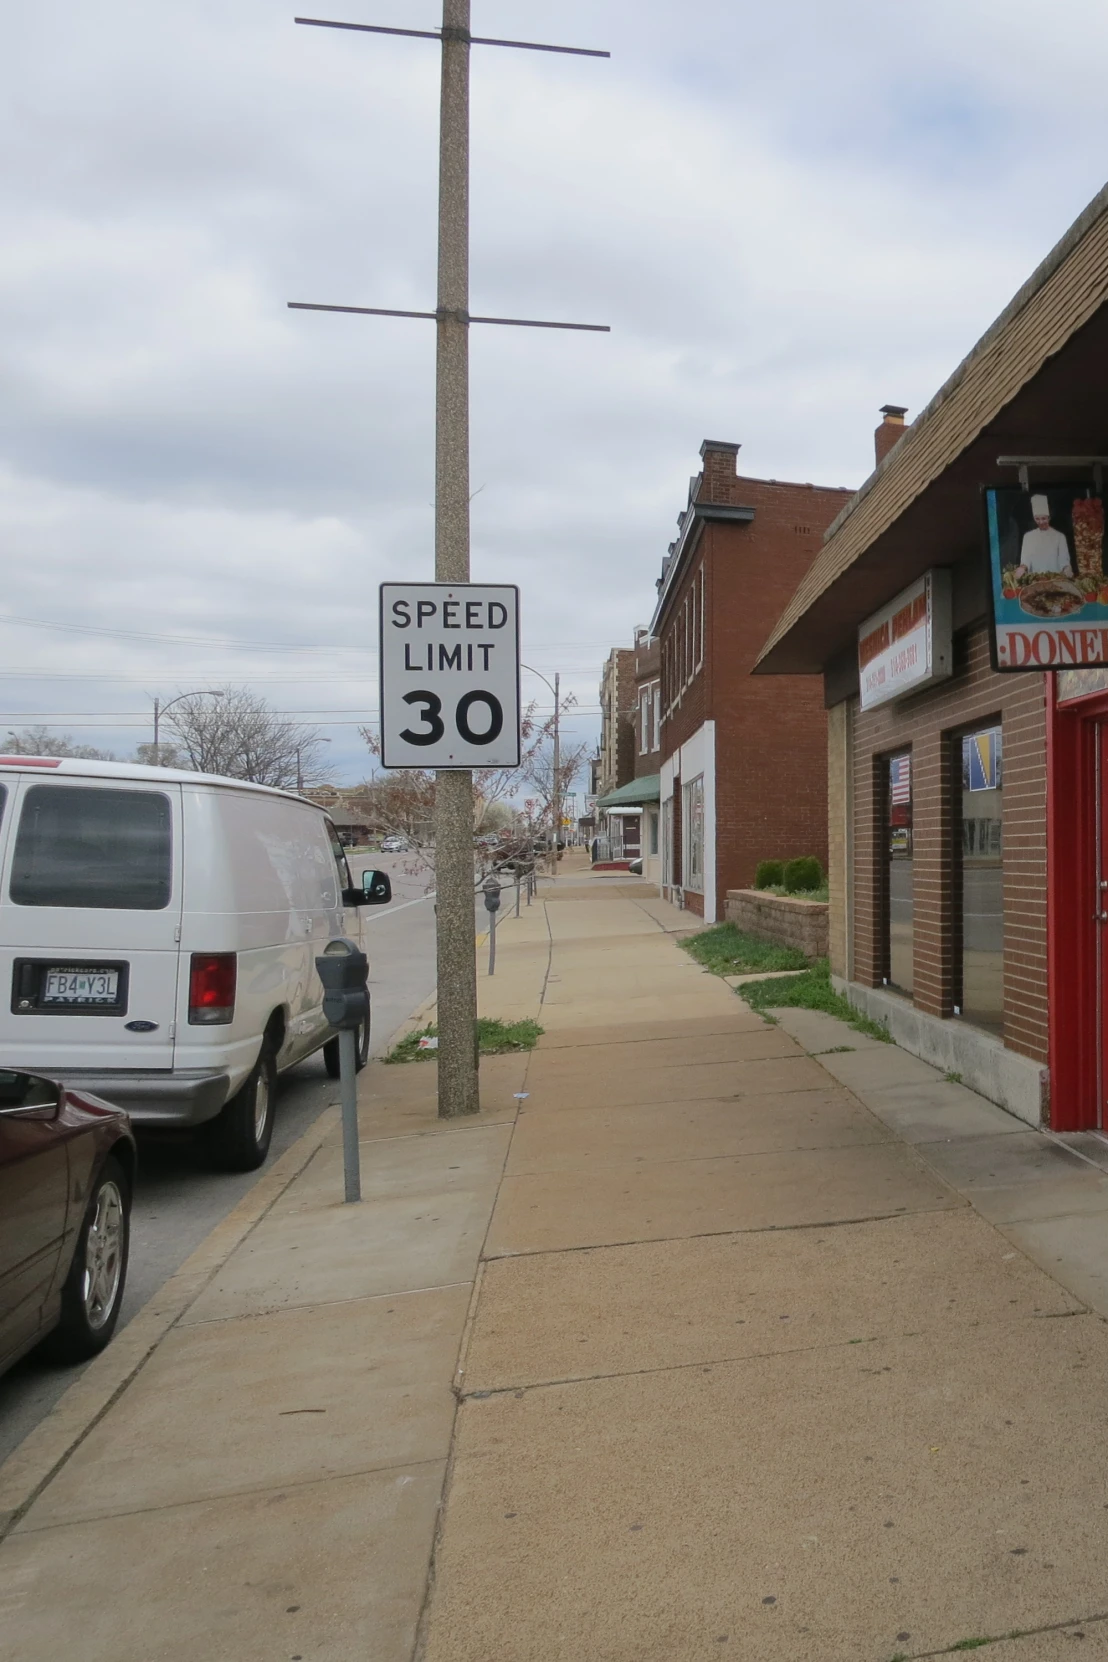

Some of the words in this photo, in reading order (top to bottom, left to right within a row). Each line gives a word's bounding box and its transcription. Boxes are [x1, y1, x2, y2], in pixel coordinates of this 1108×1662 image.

[391, 600, 508, 629] SPEED
[404, 643, 495, 671] LIMIT
[399, 689, 503, 746] 30
[47, 975, 78, 994] FB4
[87, 976, 115, 995] Y3L
